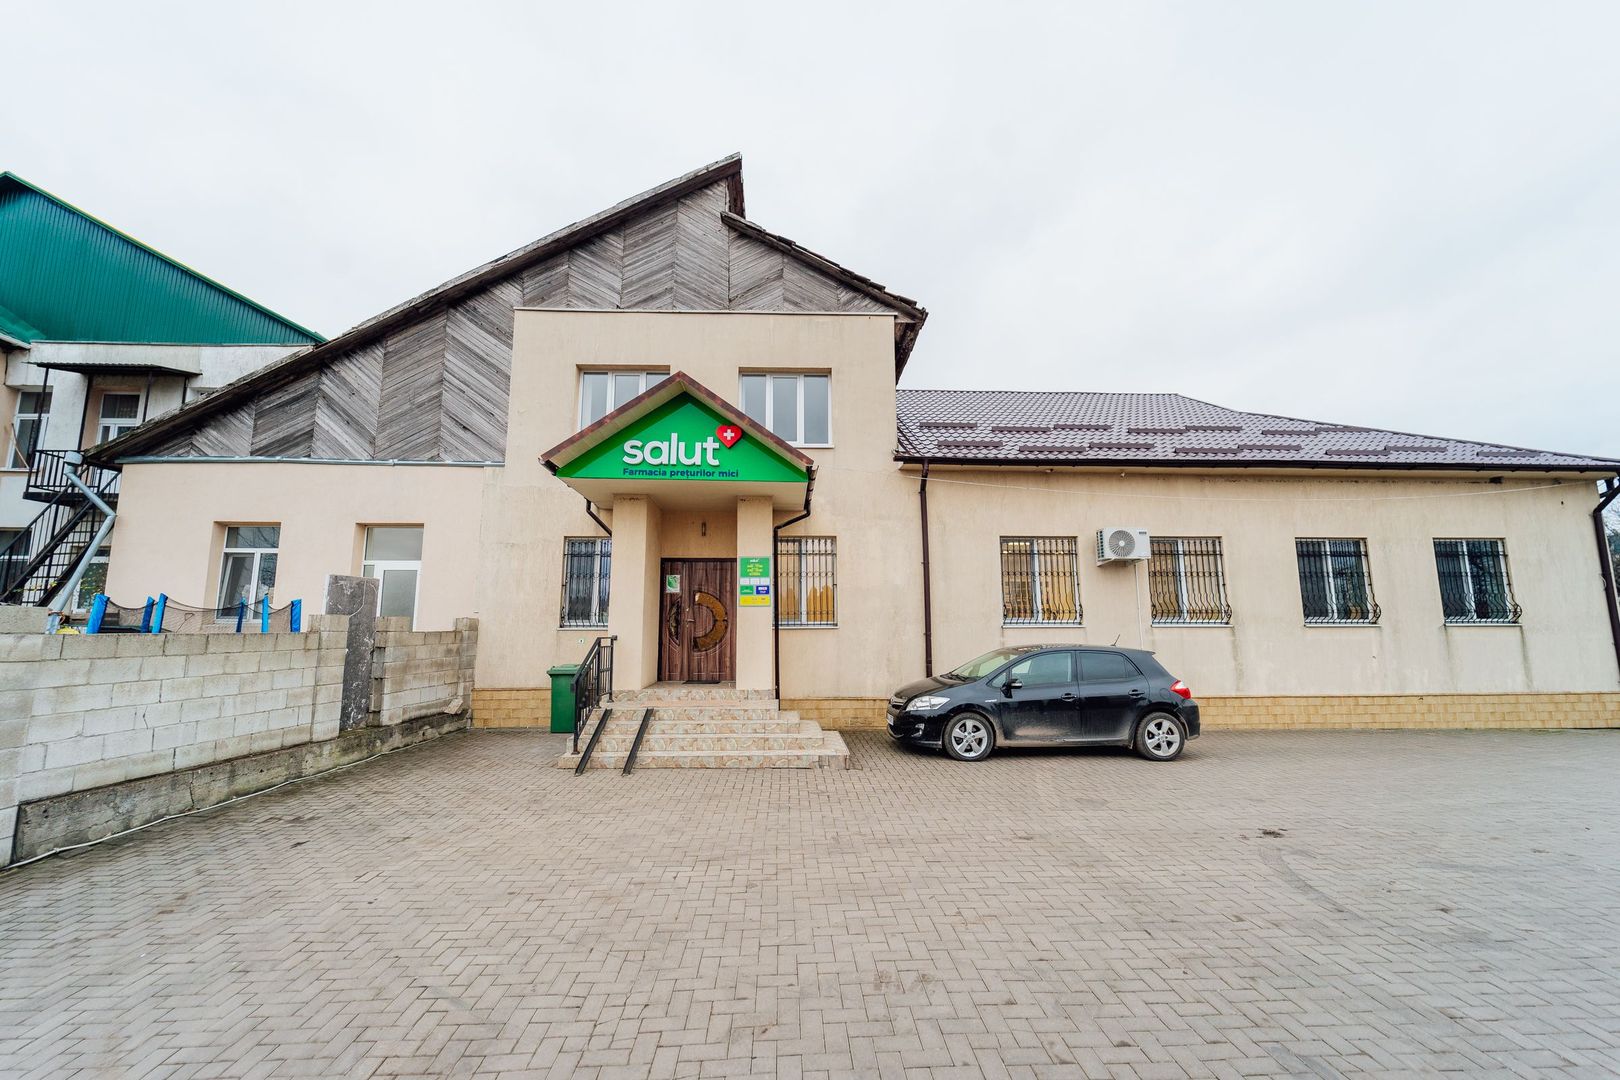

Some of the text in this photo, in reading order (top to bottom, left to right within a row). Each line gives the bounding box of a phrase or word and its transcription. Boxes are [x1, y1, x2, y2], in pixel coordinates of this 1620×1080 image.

[622, 432, 720, 466] salut
[623, 468, 667, 476] Farmacia
[718, 469, 739, 478] mici
